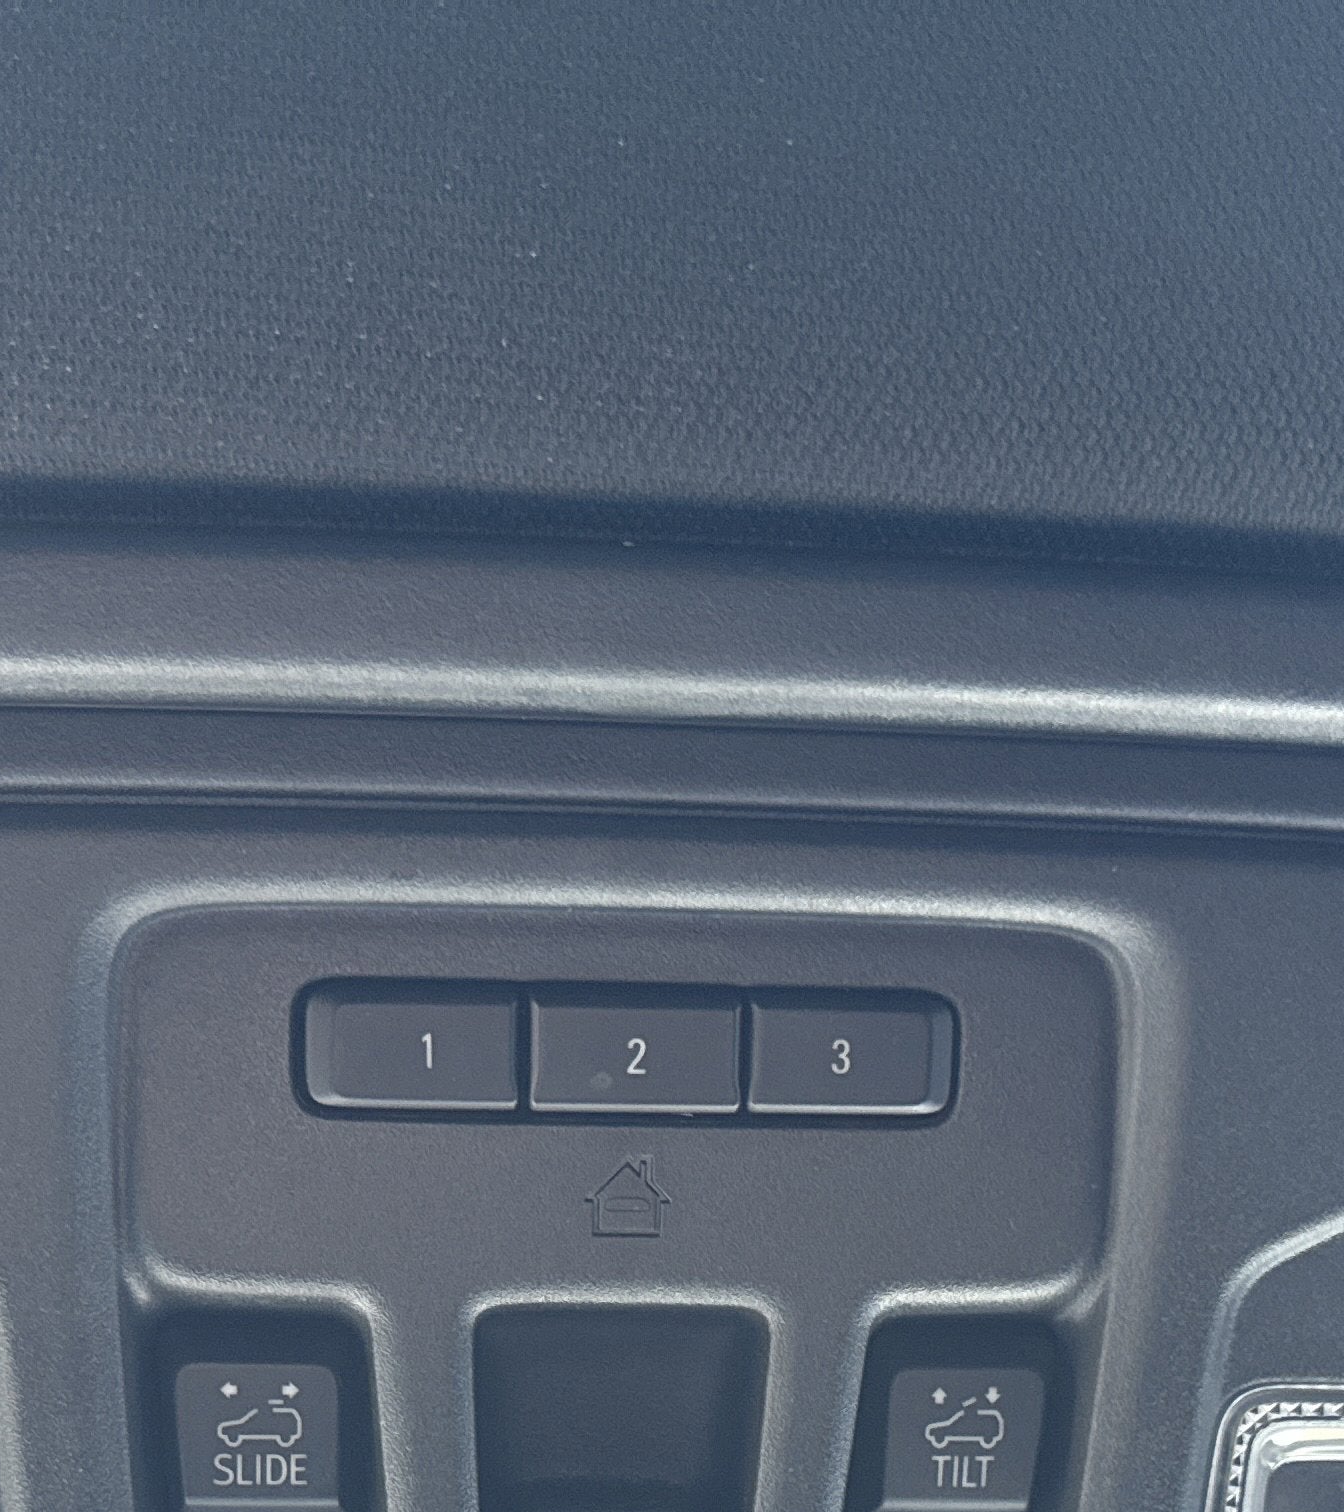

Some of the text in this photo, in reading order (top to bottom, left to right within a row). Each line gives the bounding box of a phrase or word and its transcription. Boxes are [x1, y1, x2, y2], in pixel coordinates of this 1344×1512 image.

[421, 1032, 433, 1069] 1
[626, 1037, 647, 1075] 2
[830, 1039, 852, 1075] 3
[212, 1452, 308, 1487] SLIDE
[931, 1454, 996, 1489] TILT
